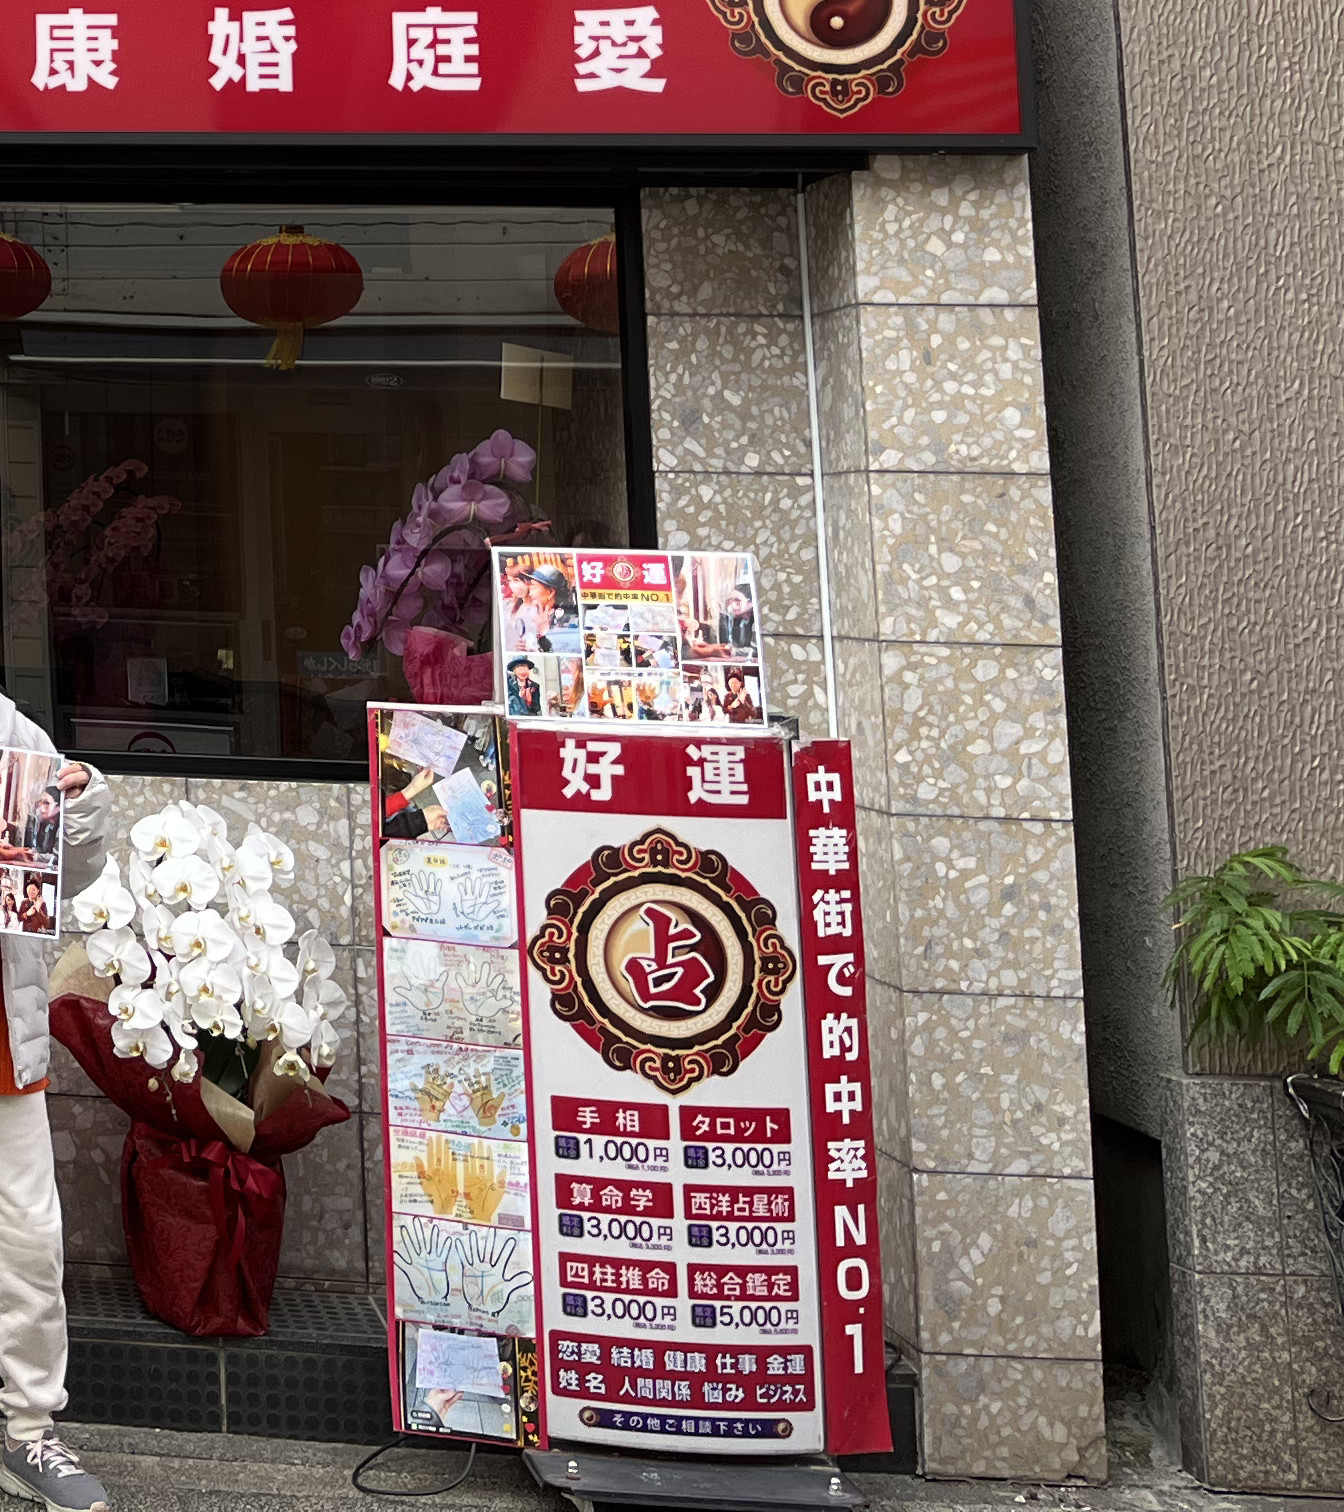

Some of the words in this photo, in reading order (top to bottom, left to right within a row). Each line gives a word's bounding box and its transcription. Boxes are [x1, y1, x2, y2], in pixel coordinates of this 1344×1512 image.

[576, 1106, 640, 1133] 手相
[691, 1113, 780, 1138] タロット
[569, 1181, 654, 1212] 算命学
[690, 1191, 790, 1218] 西洋占星術
[565, 1261, 671, 1292] 四柱推命
[693, 1271, 793, 1297] 総合鑑定
[557, 1339, 602, 1365] 恋愛
[610, 1345, 655, 1370] 結婚
[664, 1350, 707, 1373] 健康
[715, 1353, 758, 1375] 仕事
[765, 1354, 806, 1376] 金運
[558, 1368, 606, 1395] 姓名
[618, 1376, 692, 1402] 人間関係
[702, 1381, 745, 1404] 悩み
[755, 1383, 808, 1405] ビジネス
[612, 1412, 763, 1435] その他ご相談下さい
